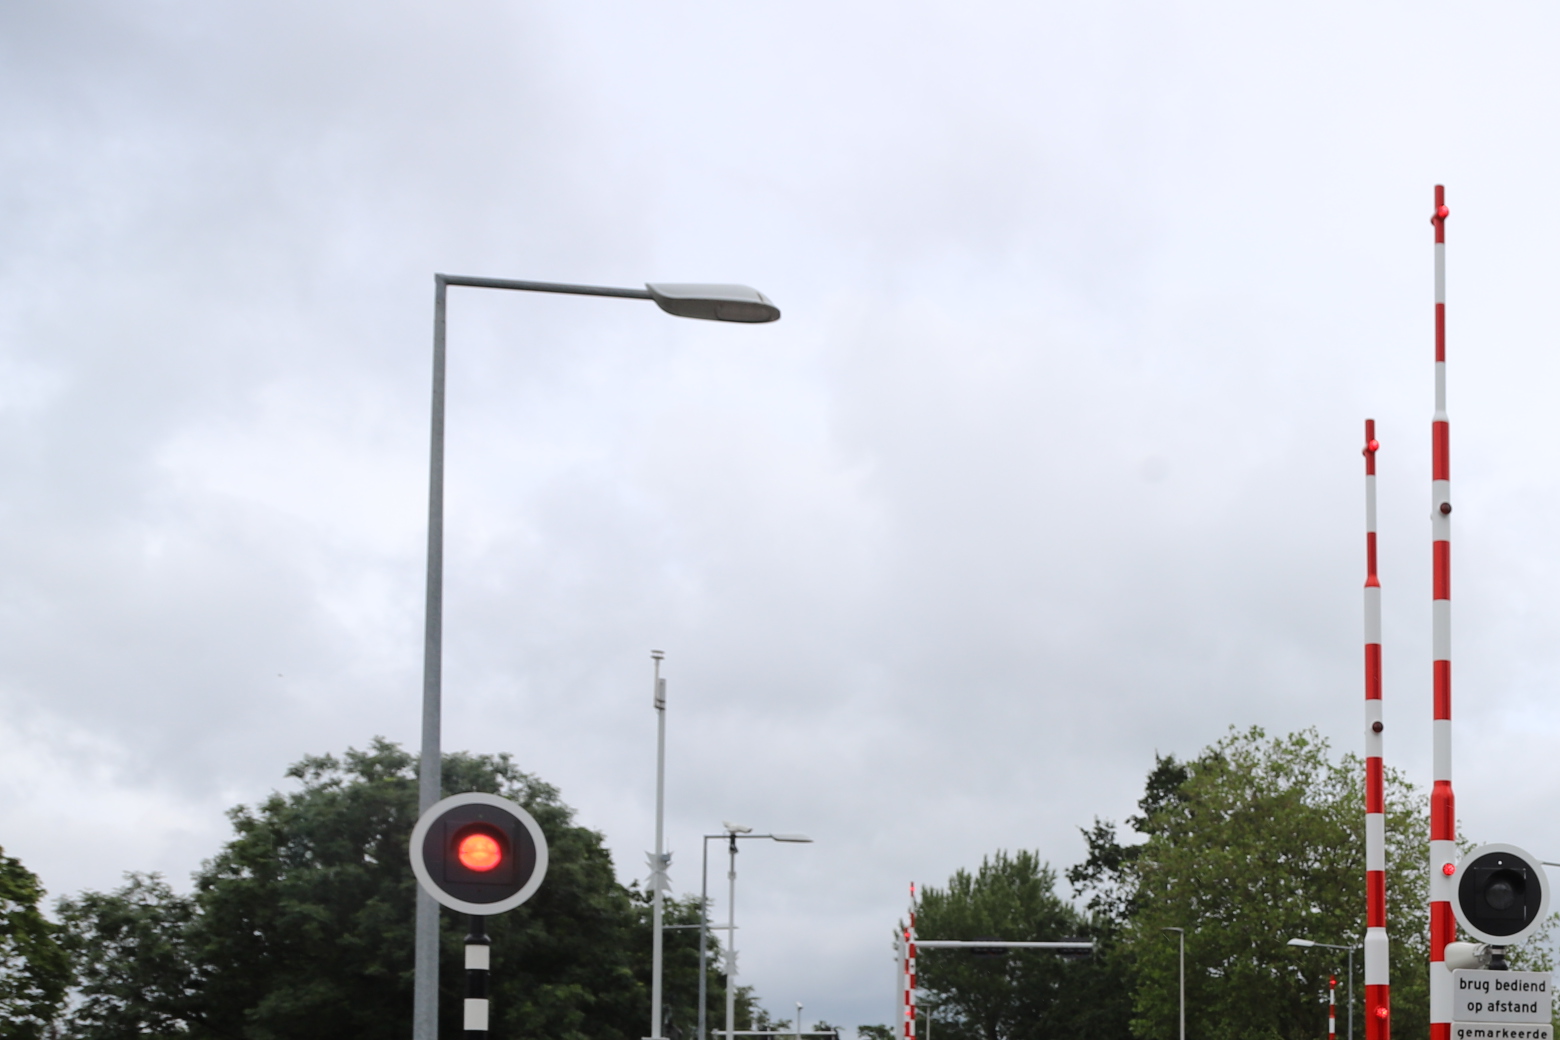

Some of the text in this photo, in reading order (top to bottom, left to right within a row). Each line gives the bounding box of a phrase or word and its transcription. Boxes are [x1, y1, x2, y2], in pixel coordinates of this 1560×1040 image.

[1459, 977, 1546, 994] brug bediend
[1467, 1000, 1537, 1014] op afstand
[1457, 1028, 1548, 1040] gemarkeerde
